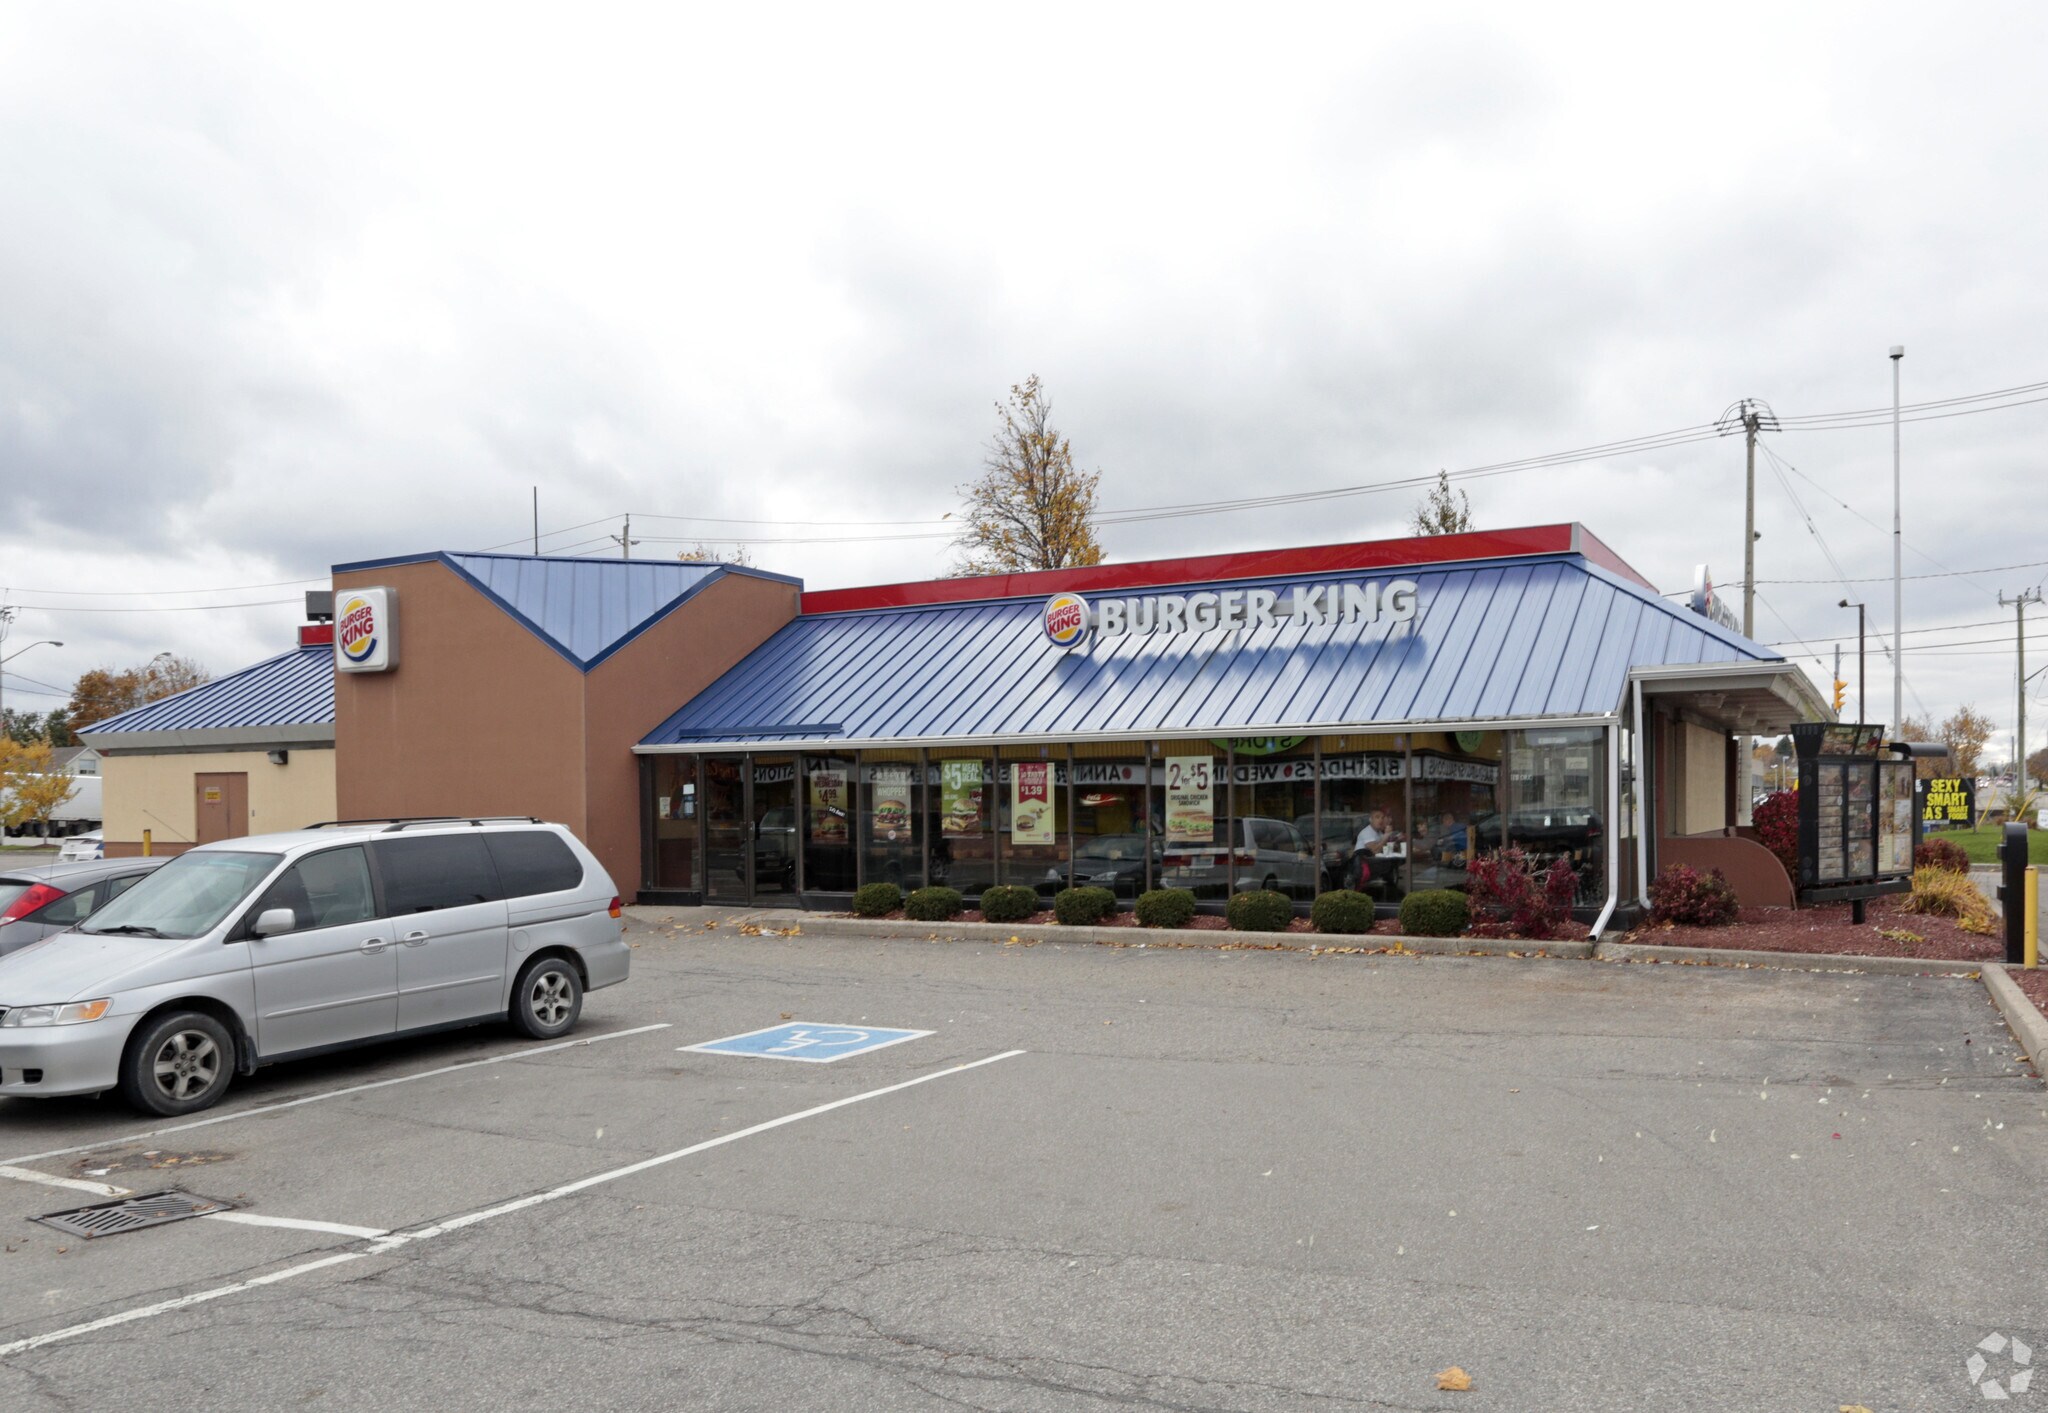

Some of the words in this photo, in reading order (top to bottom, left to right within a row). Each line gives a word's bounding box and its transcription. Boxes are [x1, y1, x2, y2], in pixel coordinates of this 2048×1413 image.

[1047, 604, 1080, 624] BURGER
[1099, 589, 1279, 637] BURGER
[1293, 580, 1418, 627] KING
[340, 606, 373, 634] BURGER
[1048, 613, 1081, 637] KING
[341, 617, 374, 651] KING
[1169, 763, 1181, 790] 2
[1181, 775, 1191, 785] for
[1190, 763, 1208, 790] $5
[1931, 779, 1961, 793] SEXY
[877, 786, 906, 796] WHOPPER
[1020, 786, 1043, 796] $1.39
[1926, 793, 1967, 806] SMART
